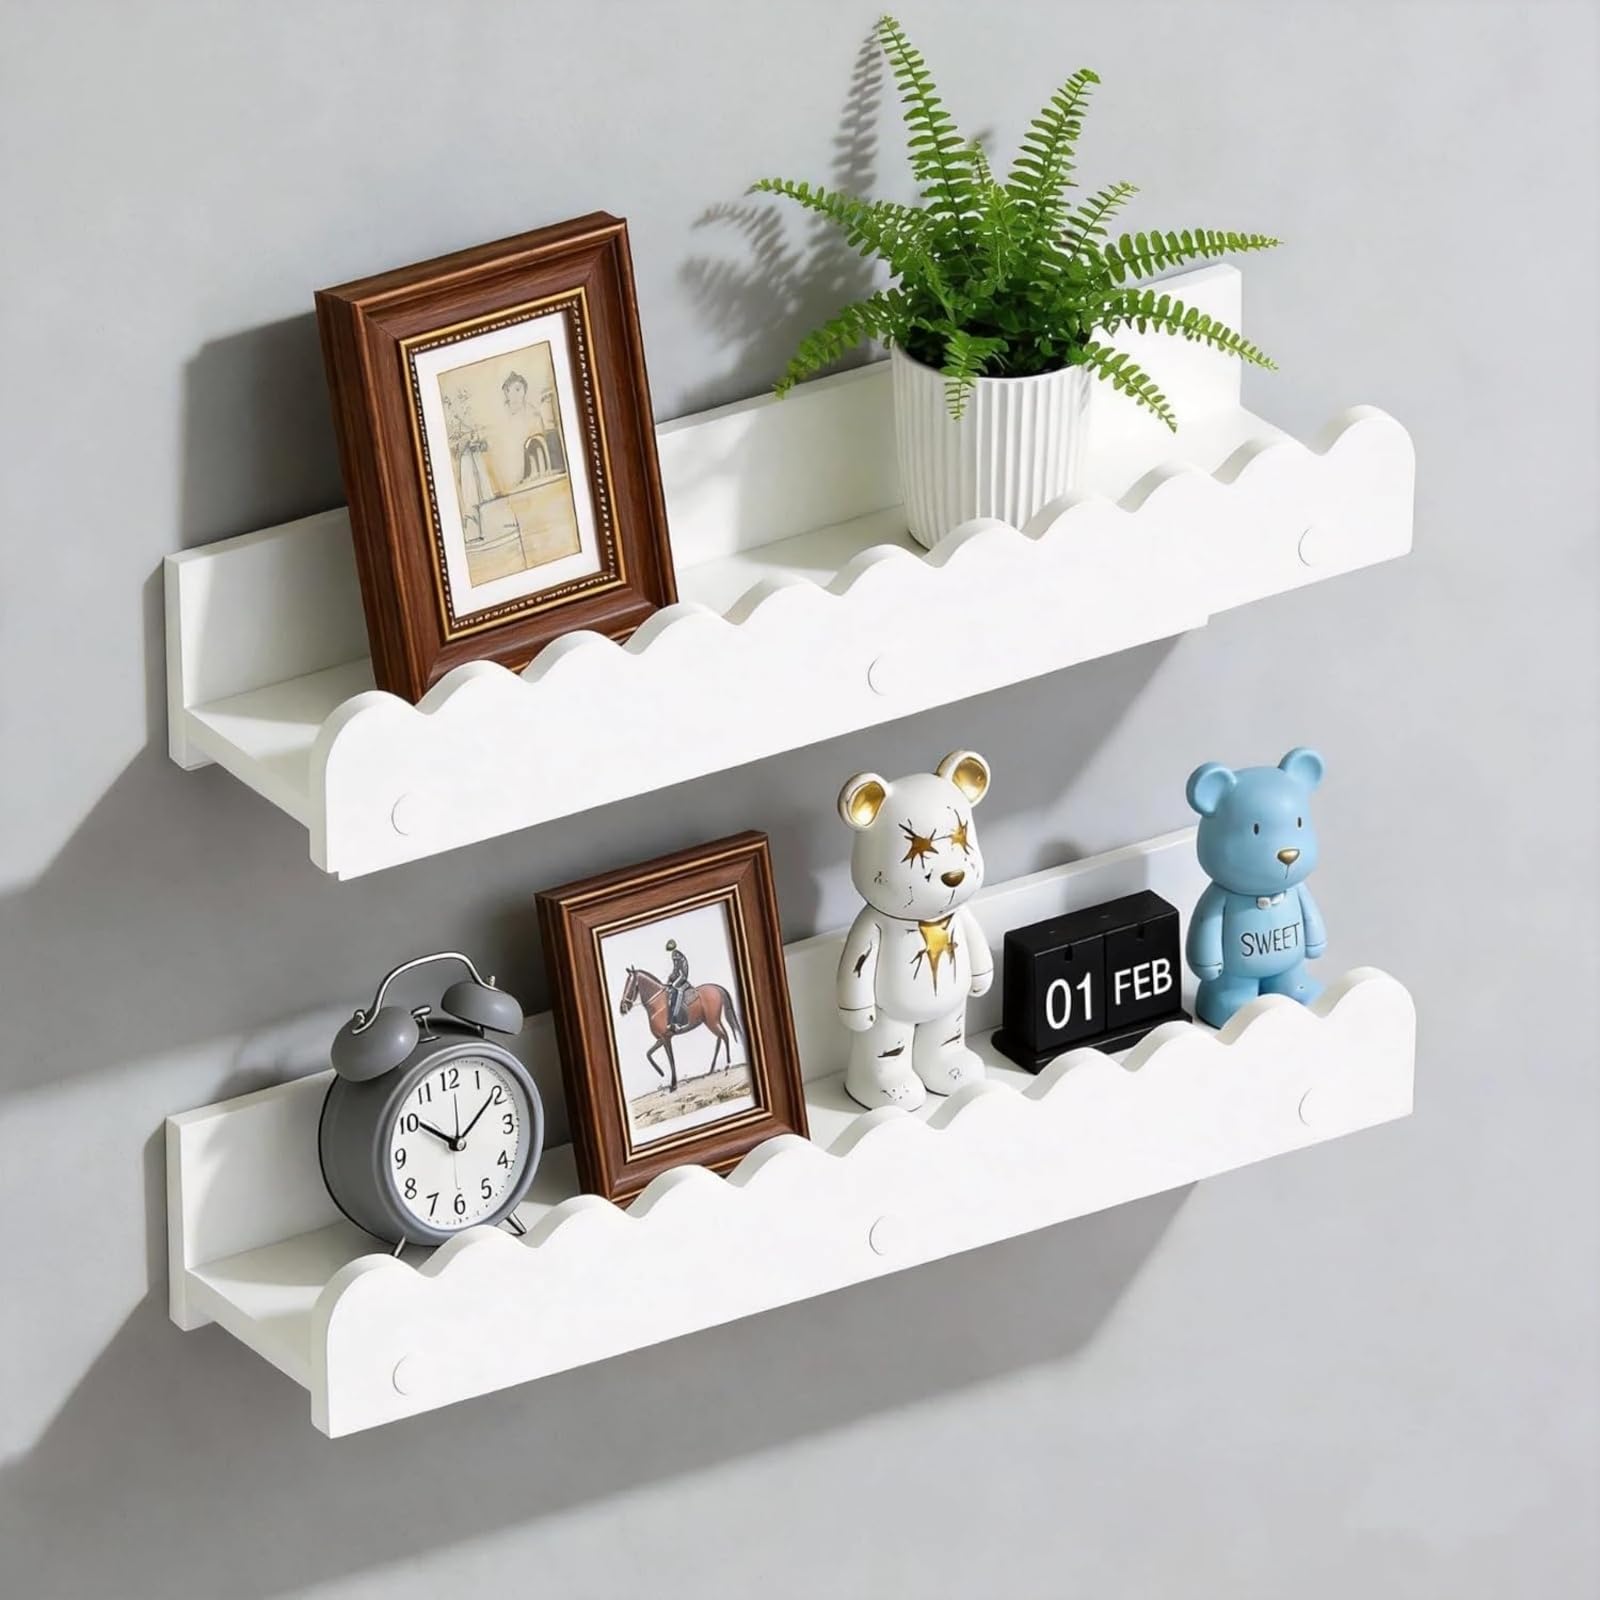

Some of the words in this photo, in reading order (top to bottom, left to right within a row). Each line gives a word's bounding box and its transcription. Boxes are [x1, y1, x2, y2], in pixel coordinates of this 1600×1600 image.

[1241, 922, 1301, 957] SWEET
[1045, 971, 1092, 1030] 01
[1114, 957, 1173, 1005] FEB
[440, 1068, 460, 1091] 12
[475, 1070, 480, 1089] 1
[418, 1083, 431, 1104] 11
[492, 1085, 506, 1104] 2
[400, 1113, 419, 1135] 10
[502, 1113, 514, 1134] 3
[395, 1148, 406, 1169] 9
[497, 1150, 513, 1169] 4
[404, 1177, 417, 1199] 8
[481, 1178, 492, 1199] 5
[427, 1192, 439, 1216] 7
[454, 1193, 466, 1215] 6
